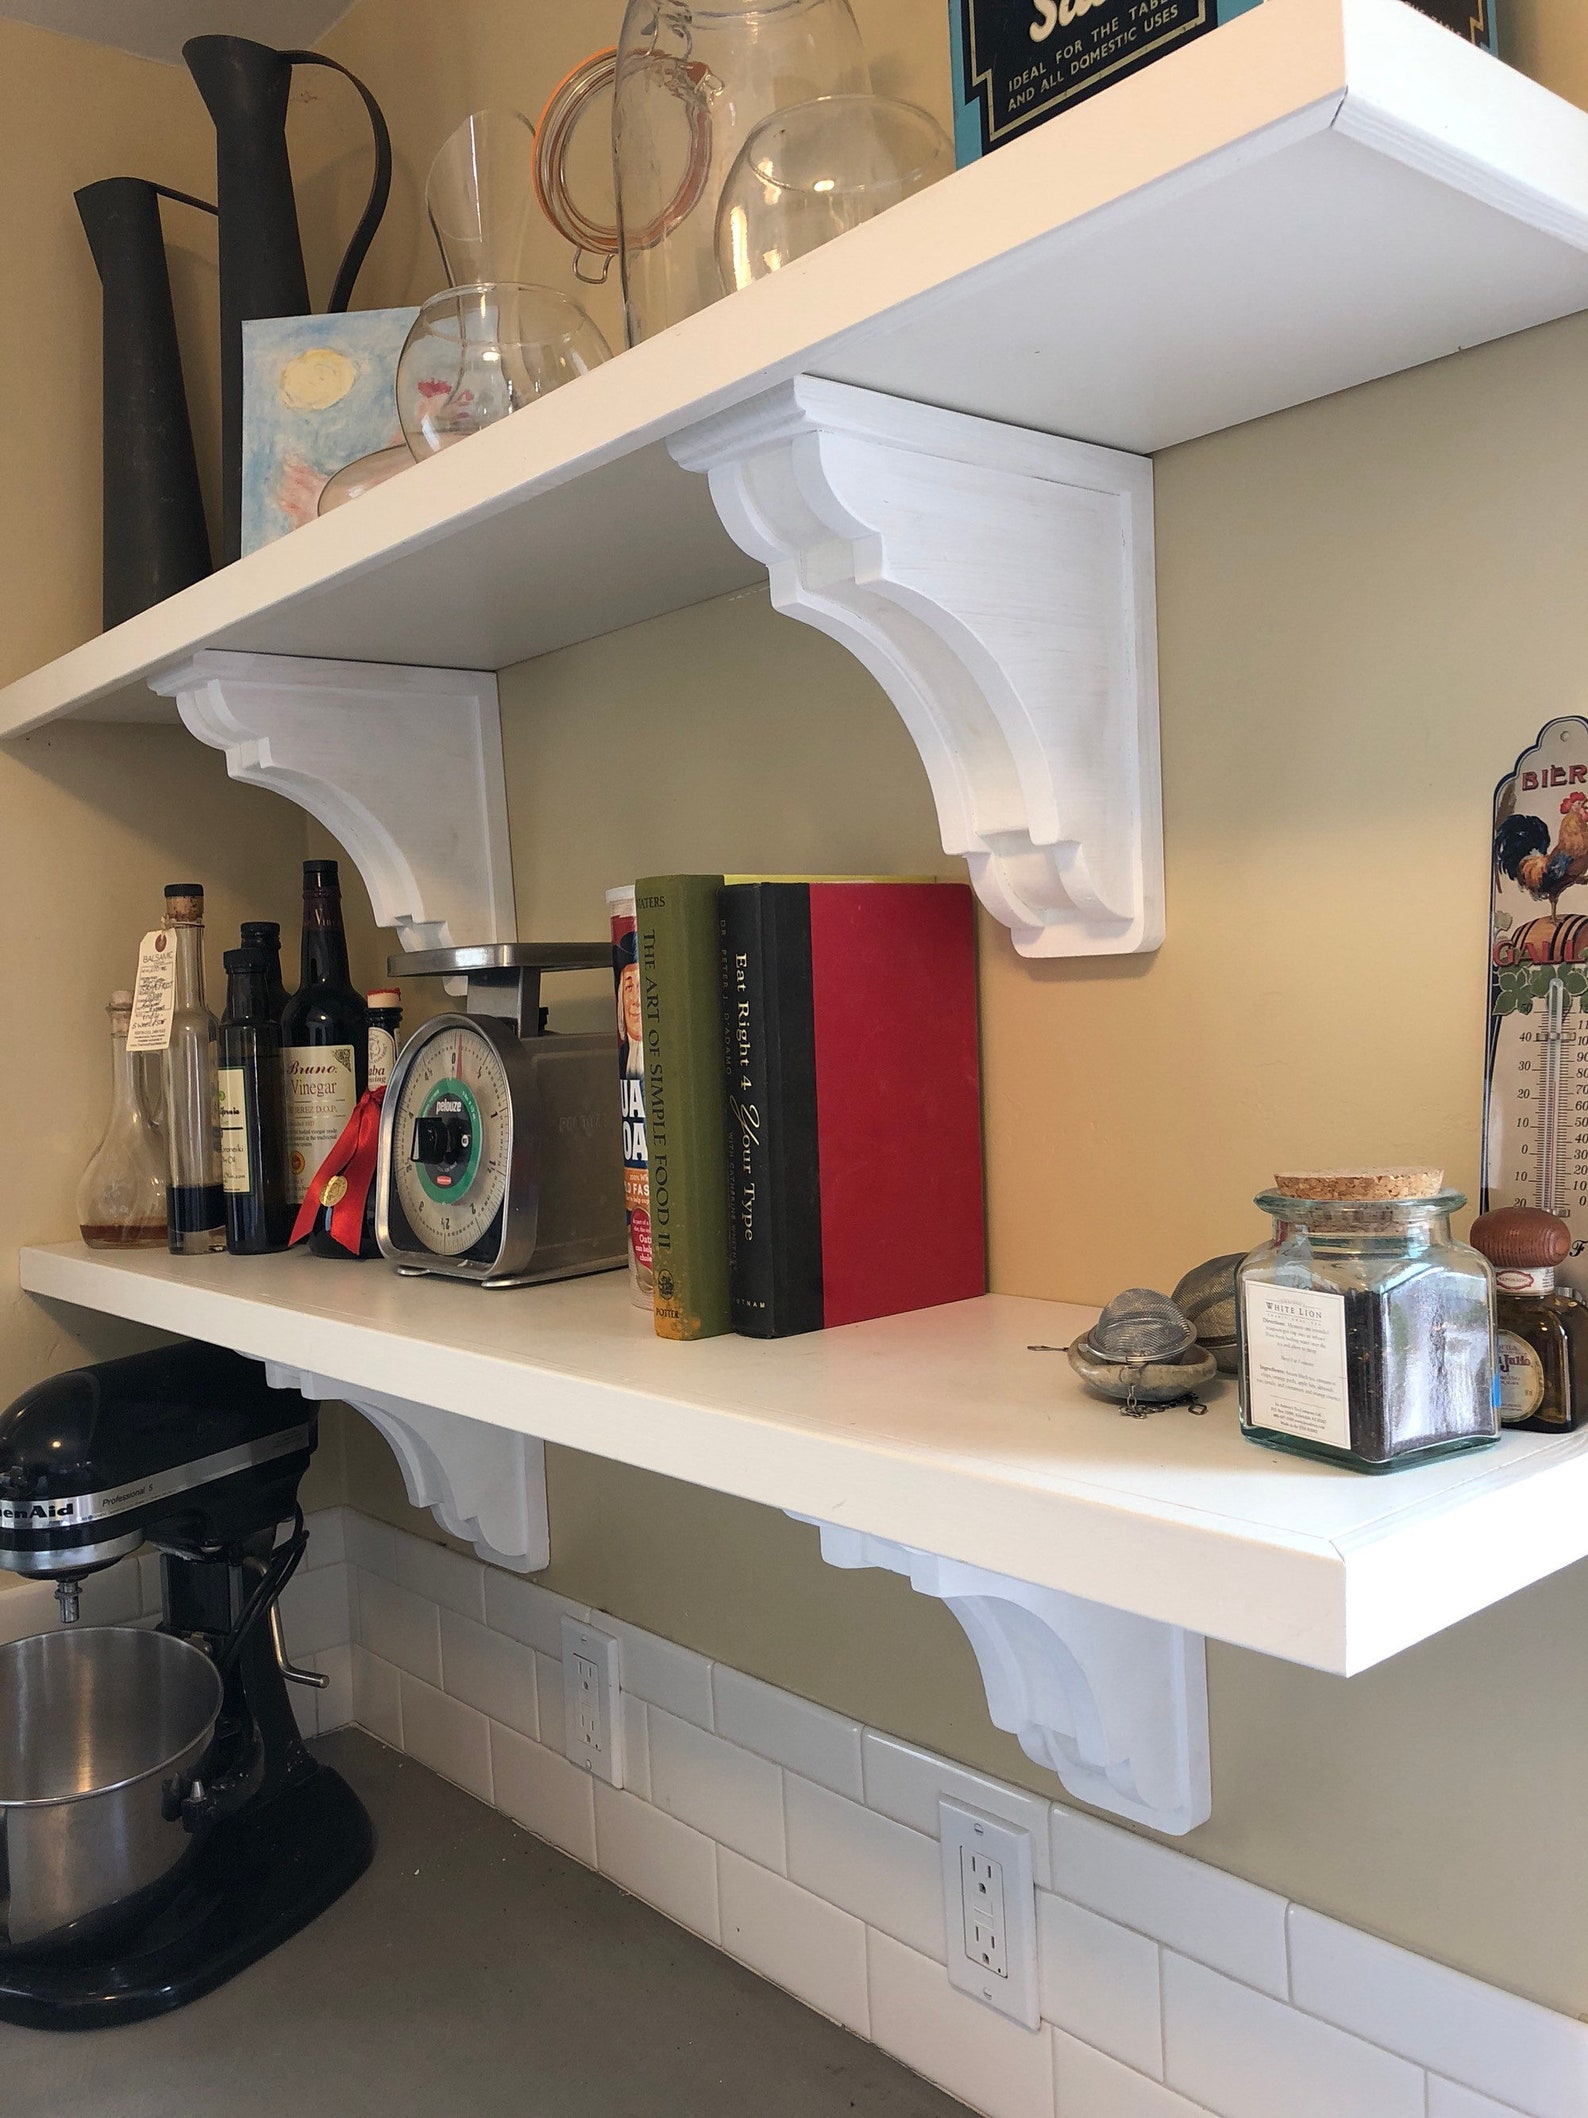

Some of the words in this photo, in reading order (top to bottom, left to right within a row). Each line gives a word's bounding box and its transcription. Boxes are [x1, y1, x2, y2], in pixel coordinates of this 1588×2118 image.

[1007, 86, 1035, 112] AND
[1040, 73, 1065, 93] ALL
[1070, 32, 1138, 76] DOMESTIC
[1143, 4, 1179, 33] USES
[1008, 62, 1047, 92] IDEAL
[1055, 39, 1083, 65] FOR
[1091, 17, 1119, 43] THE
[643, 929, 656, 970] THE
[721, 949, 729, 989] PETER
[735, 953, 747, 992] Eat
[645, 976, 660, 1023] ART
[735, 1001, 750, 1067] Right
[1518, 1032, 1532, 1043] 40
[648, 1029, 661, 1058] OF
[287, 1060, 336, 1075] Bruno
[1518, 1061, 1531, 1071] 30
[290, 1079, 337, 1097] Vinegar
[740, 1074, 752, 1091] 4
[1517, 1089, 1530, 1099] 20
[436, 1099, 462, 1115] pelouze
[650, 1064, 667, 1147] SIMPLE
[1575, 1100, 1588, 1111] 60
[1516, 1118, 1529, 1128] 10
[1574, 1117, 1588, 1127] 50
[730, 1094, 760, 1174] Your
[1574, 1133, 1588, 1144] 40
[1521, 1145, 1528, 1155] 0
[1573, 1149, 1588, 1160] 30
[1514, 1172, 1528, 1182] 10
[1573, 1165, 1588, 1175] 20
[654, 1154, 670, 1226] FOOD
[1573, 1180, 1587, 1191] 10
[1579, 1196, 1587, 1206] 0
[742, 1182, 756, 1241] Type
[656, 1308, 680, 1320] POTTER
[1265, 1301, 1296, 1314] WHITE
[1298, 1307, 1323, 1319] LION
[102, 1488, 146, 1507] Professional
